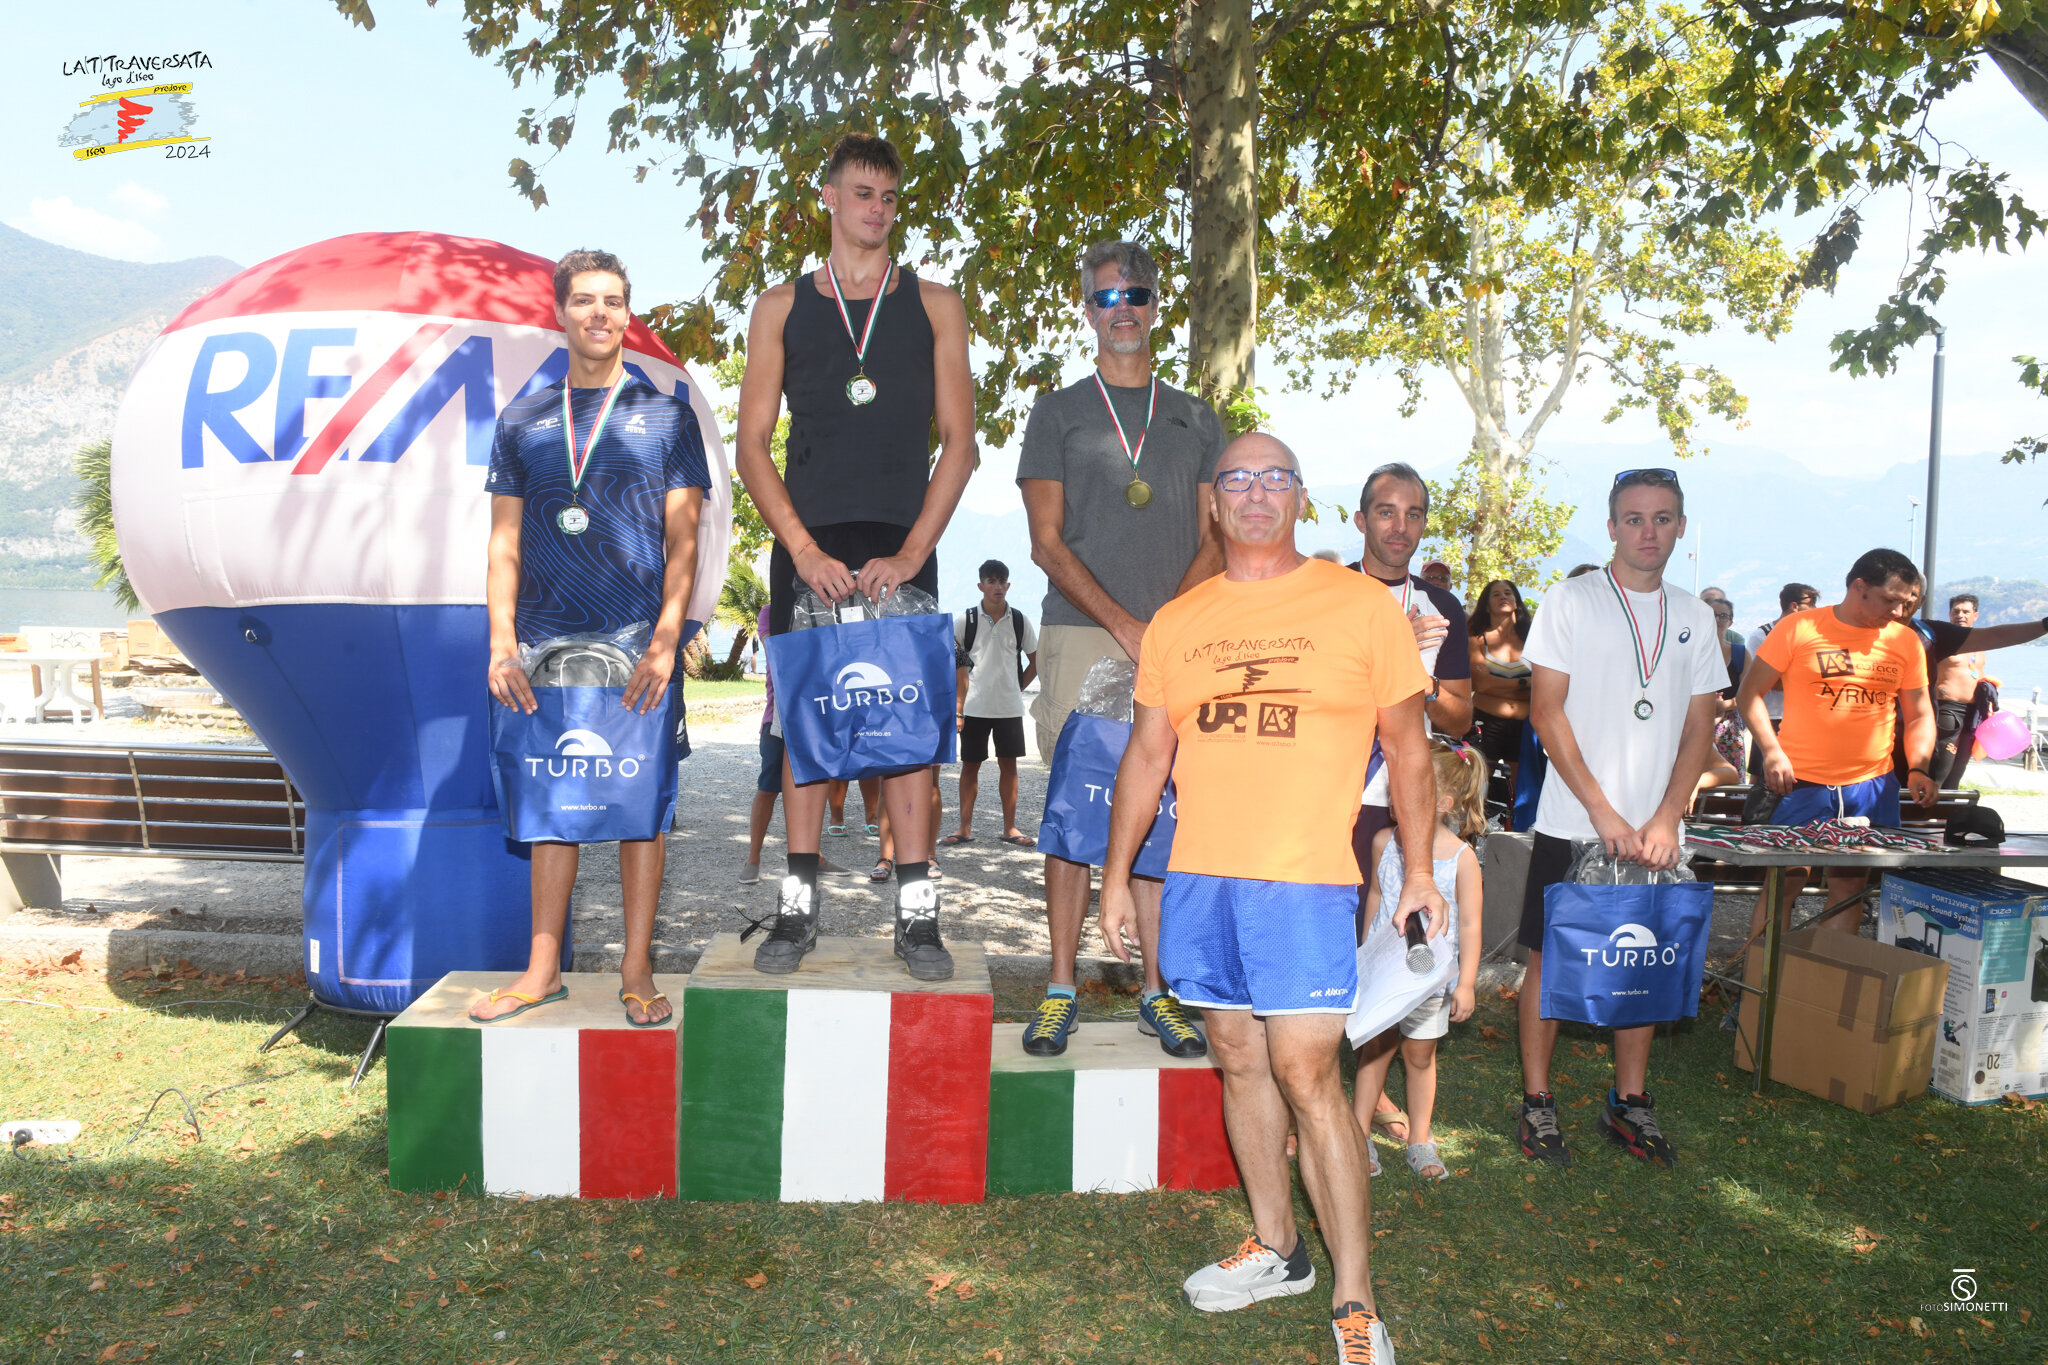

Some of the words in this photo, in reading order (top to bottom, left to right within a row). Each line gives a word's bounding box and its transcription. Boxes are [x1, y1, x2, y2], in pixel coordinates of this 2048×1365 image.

[560, 803, 607, 811] www.turbo.es
[1902, 896, 1930, 911] Portable
[1931, 905, 1952, 917] Sound
[1953, 912, 1979, 926] System
[1958, 923, 1979, 935] 700W
[1611, 988, 1649, 996] www.turbo.es
